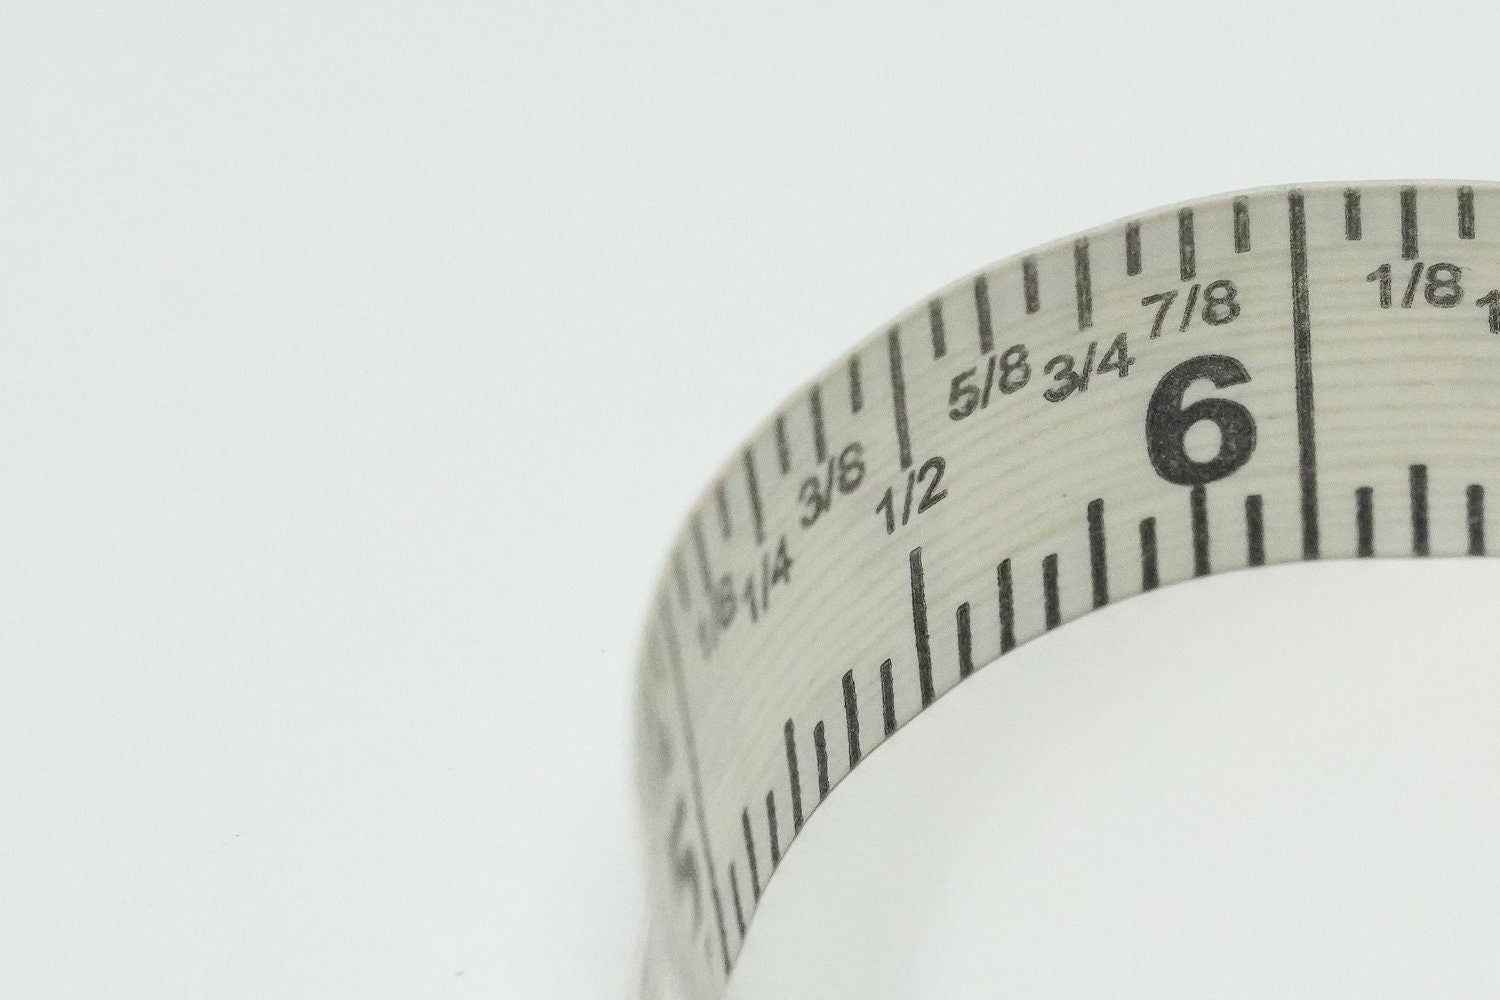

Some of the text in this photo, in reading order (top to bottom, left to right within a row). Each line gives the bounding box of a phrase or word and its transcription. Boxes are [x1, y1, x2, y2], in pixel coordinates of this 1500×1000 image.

[1141, 278, 1241, 340] 7/8
[1367, 261, 1467, 310] 1/8
[948, 343, 1033, 422] 5/8
[1042, 331, 1137, 403] 3/4
[1145, 353, 1257, 487] 6
[798, 441, 867, 529] 3/8
[875, 456, 949, 536] 1/2
[744, 535, 794, 624] 1/4
